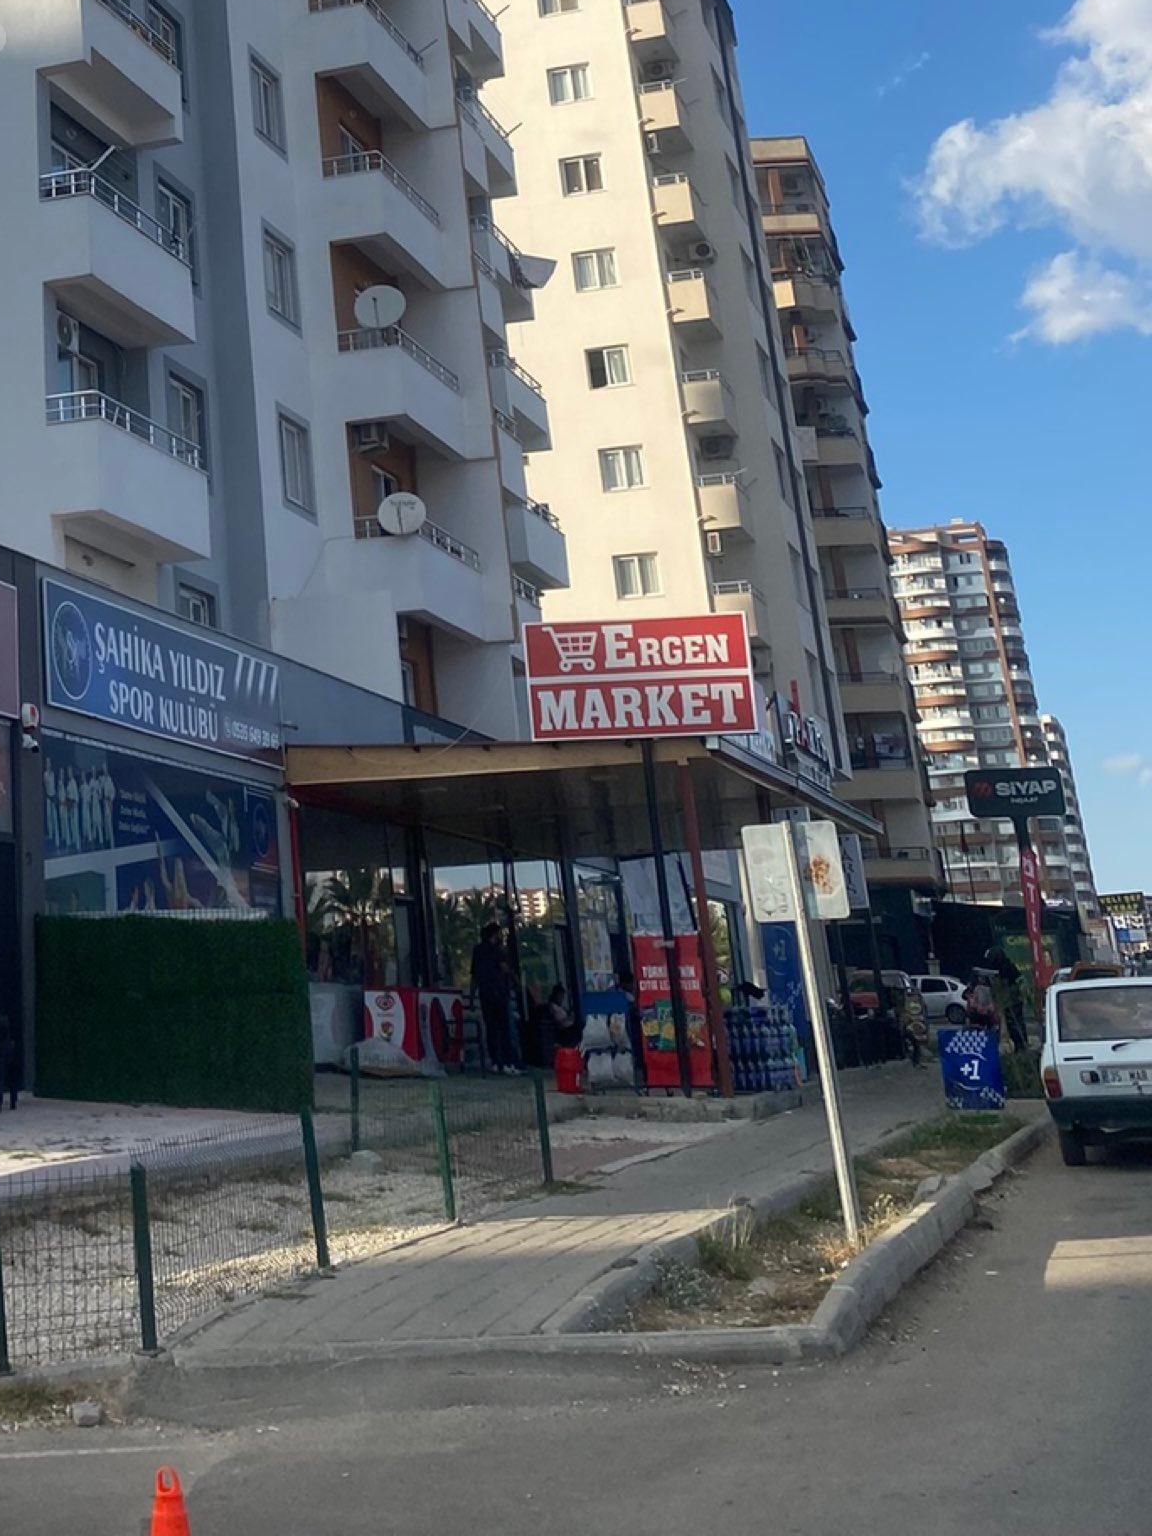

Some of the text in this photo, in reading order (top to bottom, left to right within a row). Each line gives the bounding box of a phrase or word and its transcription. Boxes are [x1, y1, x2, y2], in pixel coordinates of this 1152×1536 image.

[94, 623, 165, 682] ŞAHİKA
[169, 650, 226, 701] YILDIZ
[601, 624, 729, 668] ERGEN
[109, 680, 218, 742] SPOR KULÜBÜ
[537, 682, 744, 731] MARKET
[959, 1059, 981, 1080] +1
